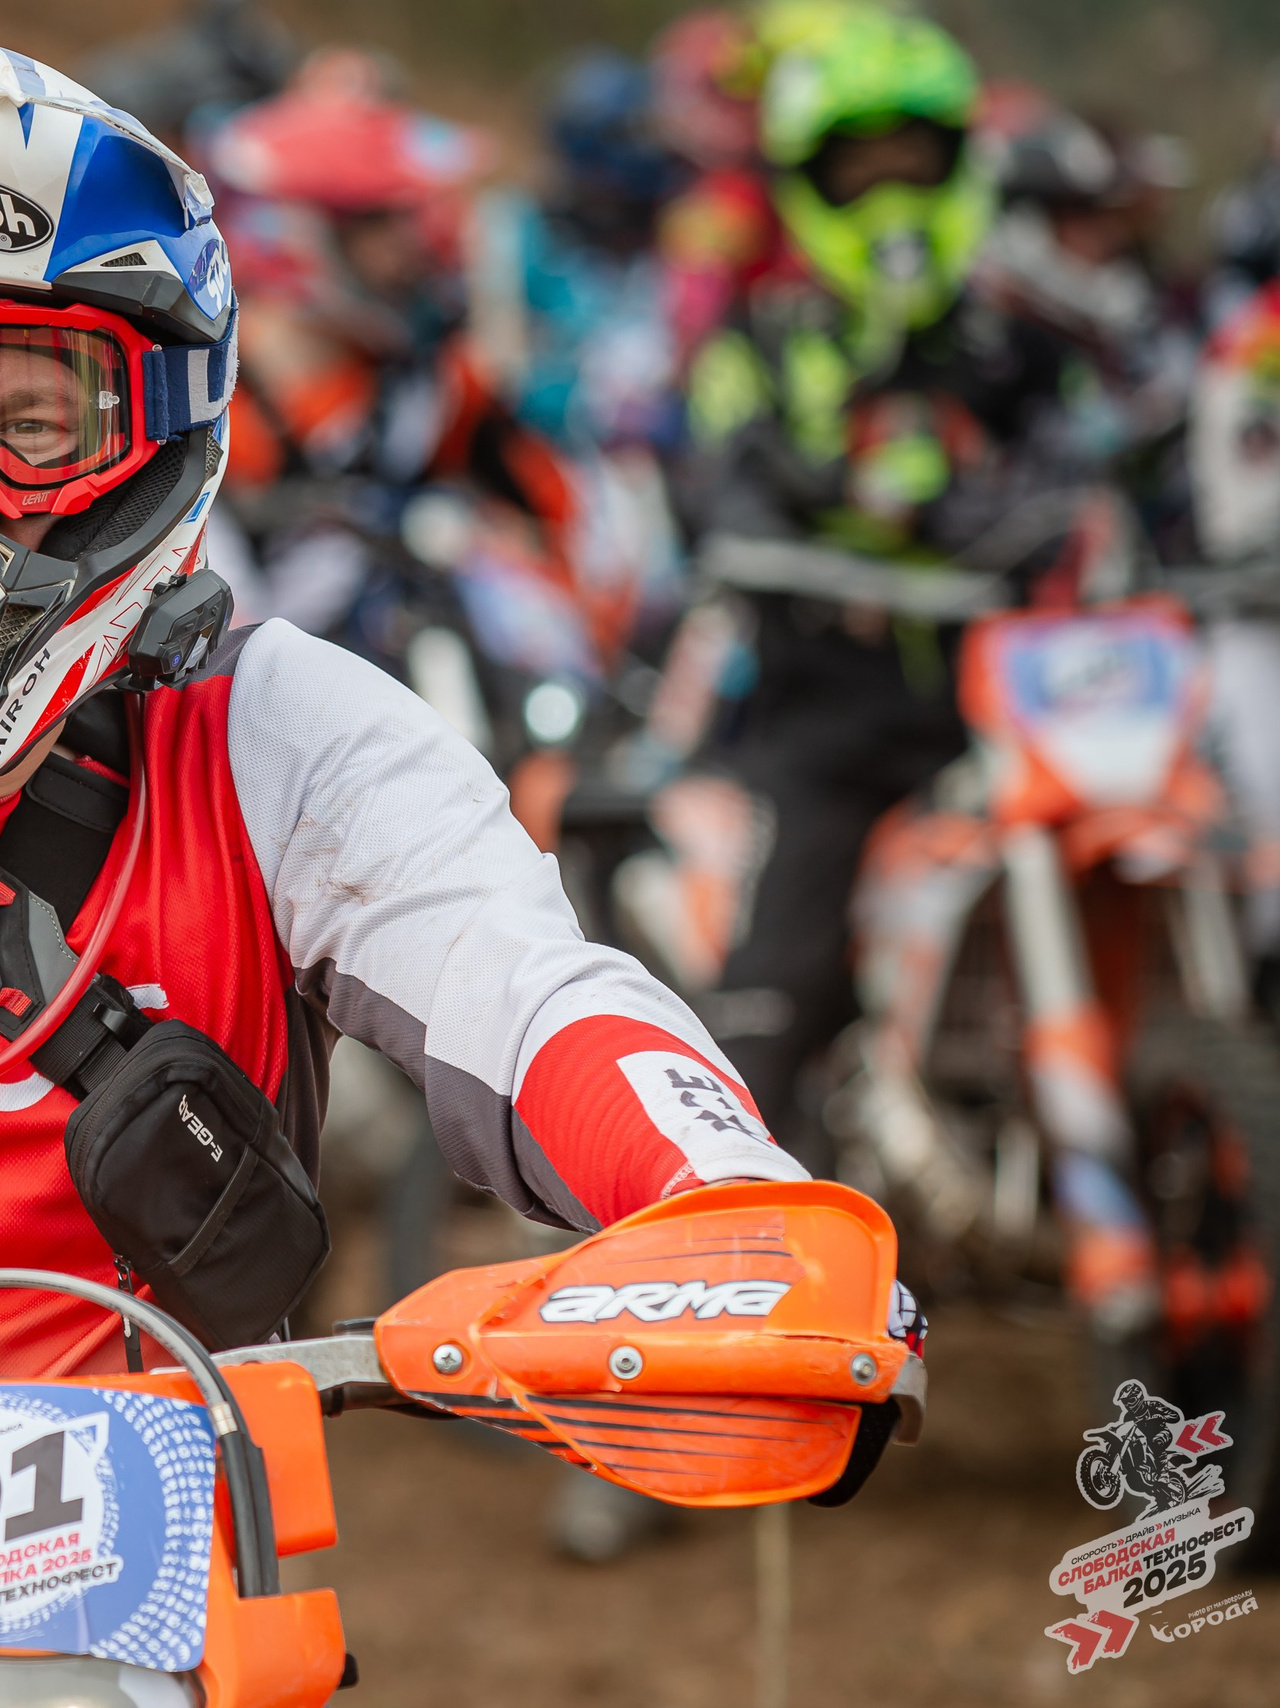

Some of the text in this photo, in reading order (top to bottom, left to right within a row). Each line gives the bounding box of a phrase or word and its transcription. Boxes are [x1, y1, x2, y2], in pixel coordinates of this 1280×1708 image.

[22, 491, 52, 506] LEATT
[178, 1093, 224, 1163] E-GEAR
[41, 1549, 92, 1575] 2025
